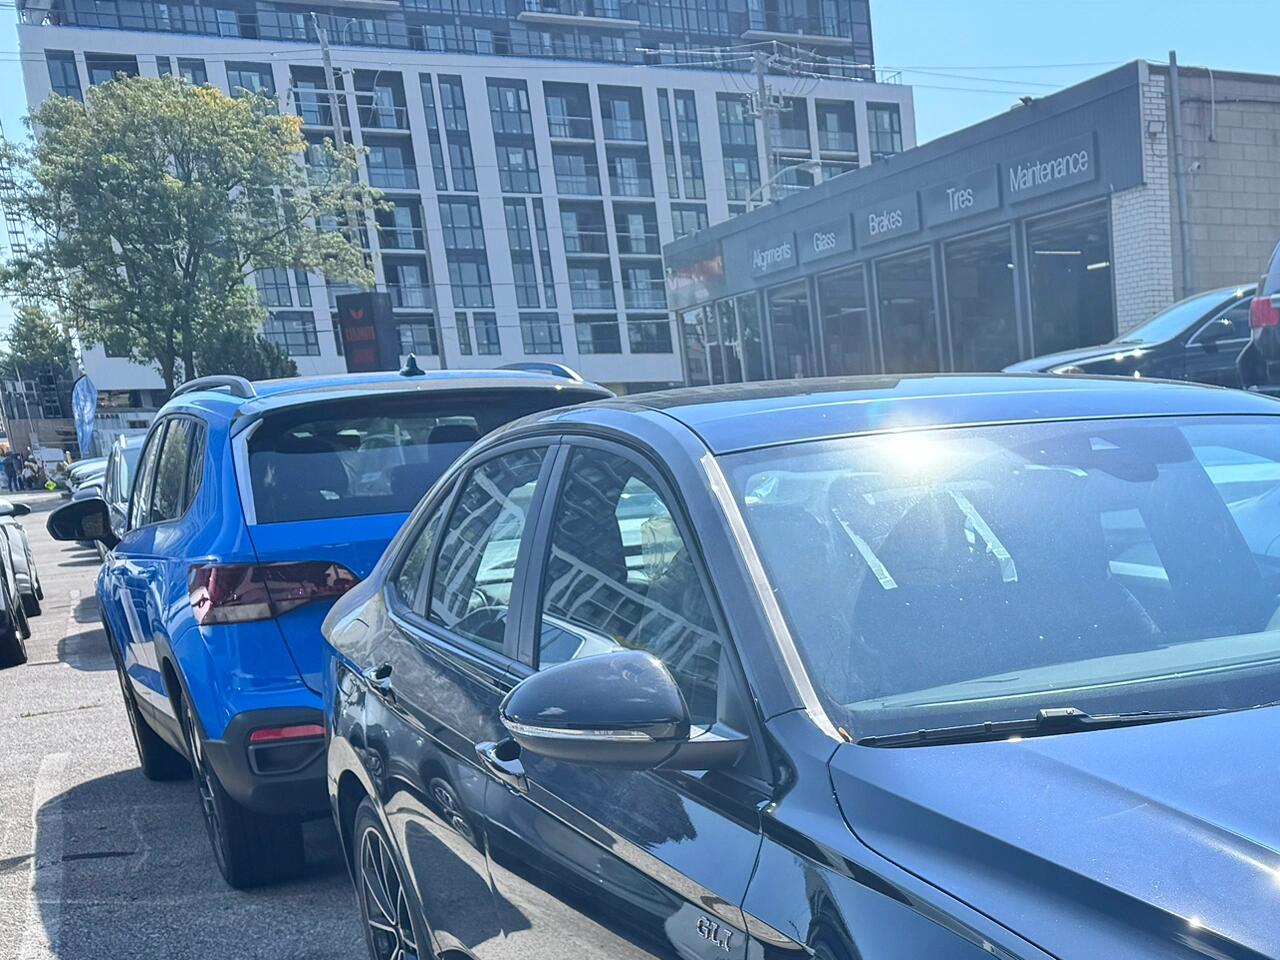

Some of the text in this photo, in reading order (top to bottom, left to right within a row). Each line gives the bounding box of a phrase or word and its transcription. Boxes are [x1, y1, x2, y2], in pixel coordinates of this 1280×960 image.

[1009, 151, 1089, 193] Maintenance
[946, 188, 974, 213] Tires
[868, 209, 903, 236] Brakes
[813, 231, 836, 253] Glass
[752, 242, 792, 271] Alignments
[696, 915, 732, 952] GLI
